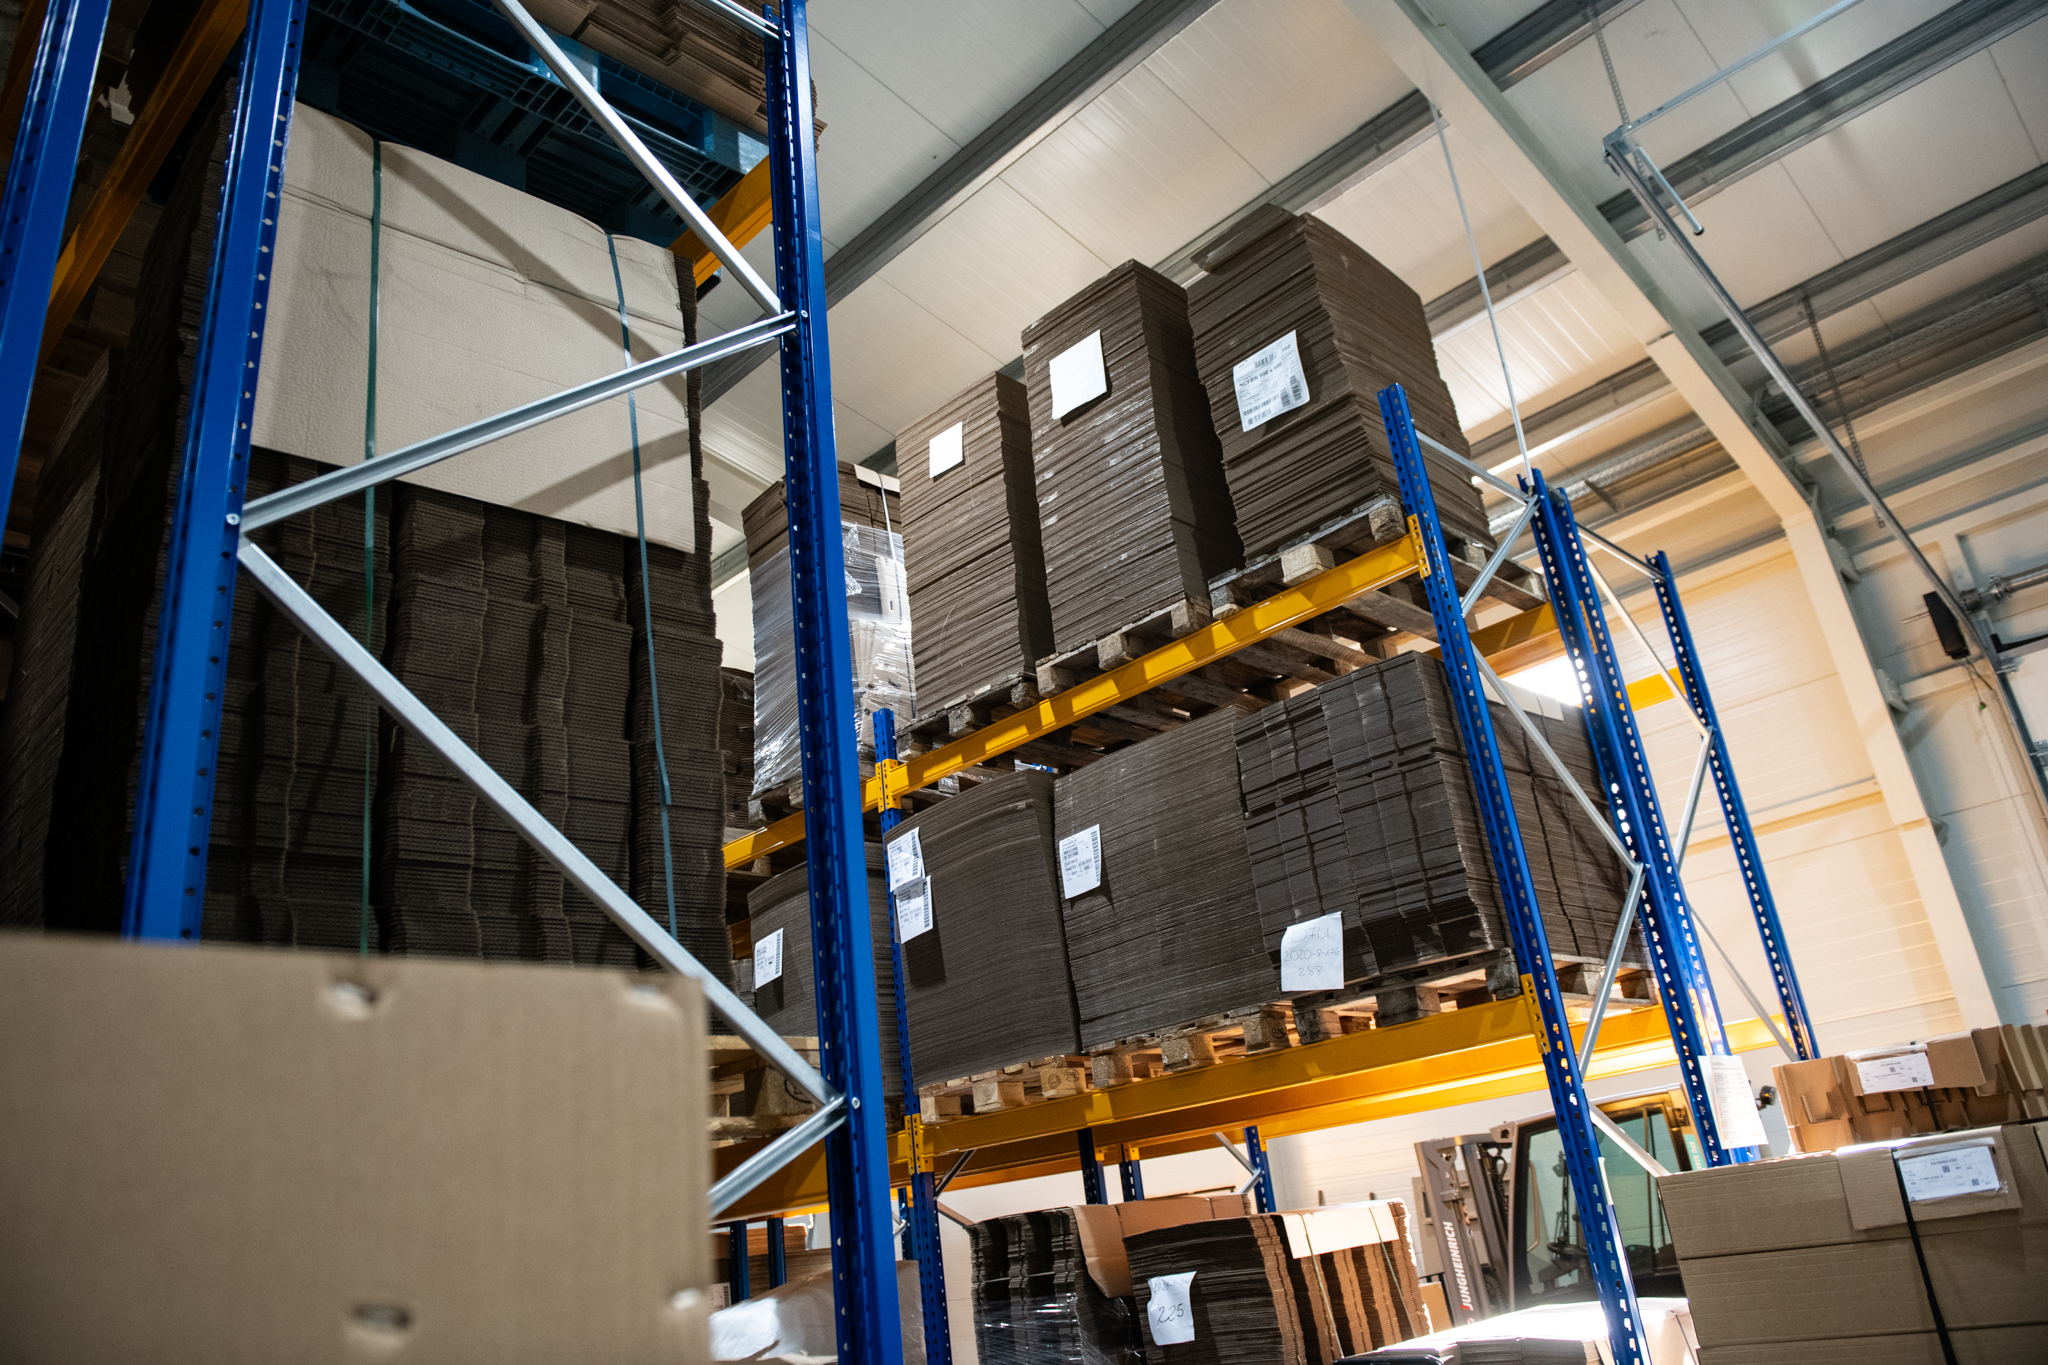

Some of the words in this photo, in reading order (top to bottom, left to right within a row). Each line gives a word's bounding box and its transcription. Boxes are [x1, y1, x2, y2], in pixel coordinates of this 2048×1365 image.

[1298, 965, 1323, 977] 288
[1443, 1221, 1474, 1311] JUNGHEINRICH
[1157, 1303, 1185, 1325] 225
